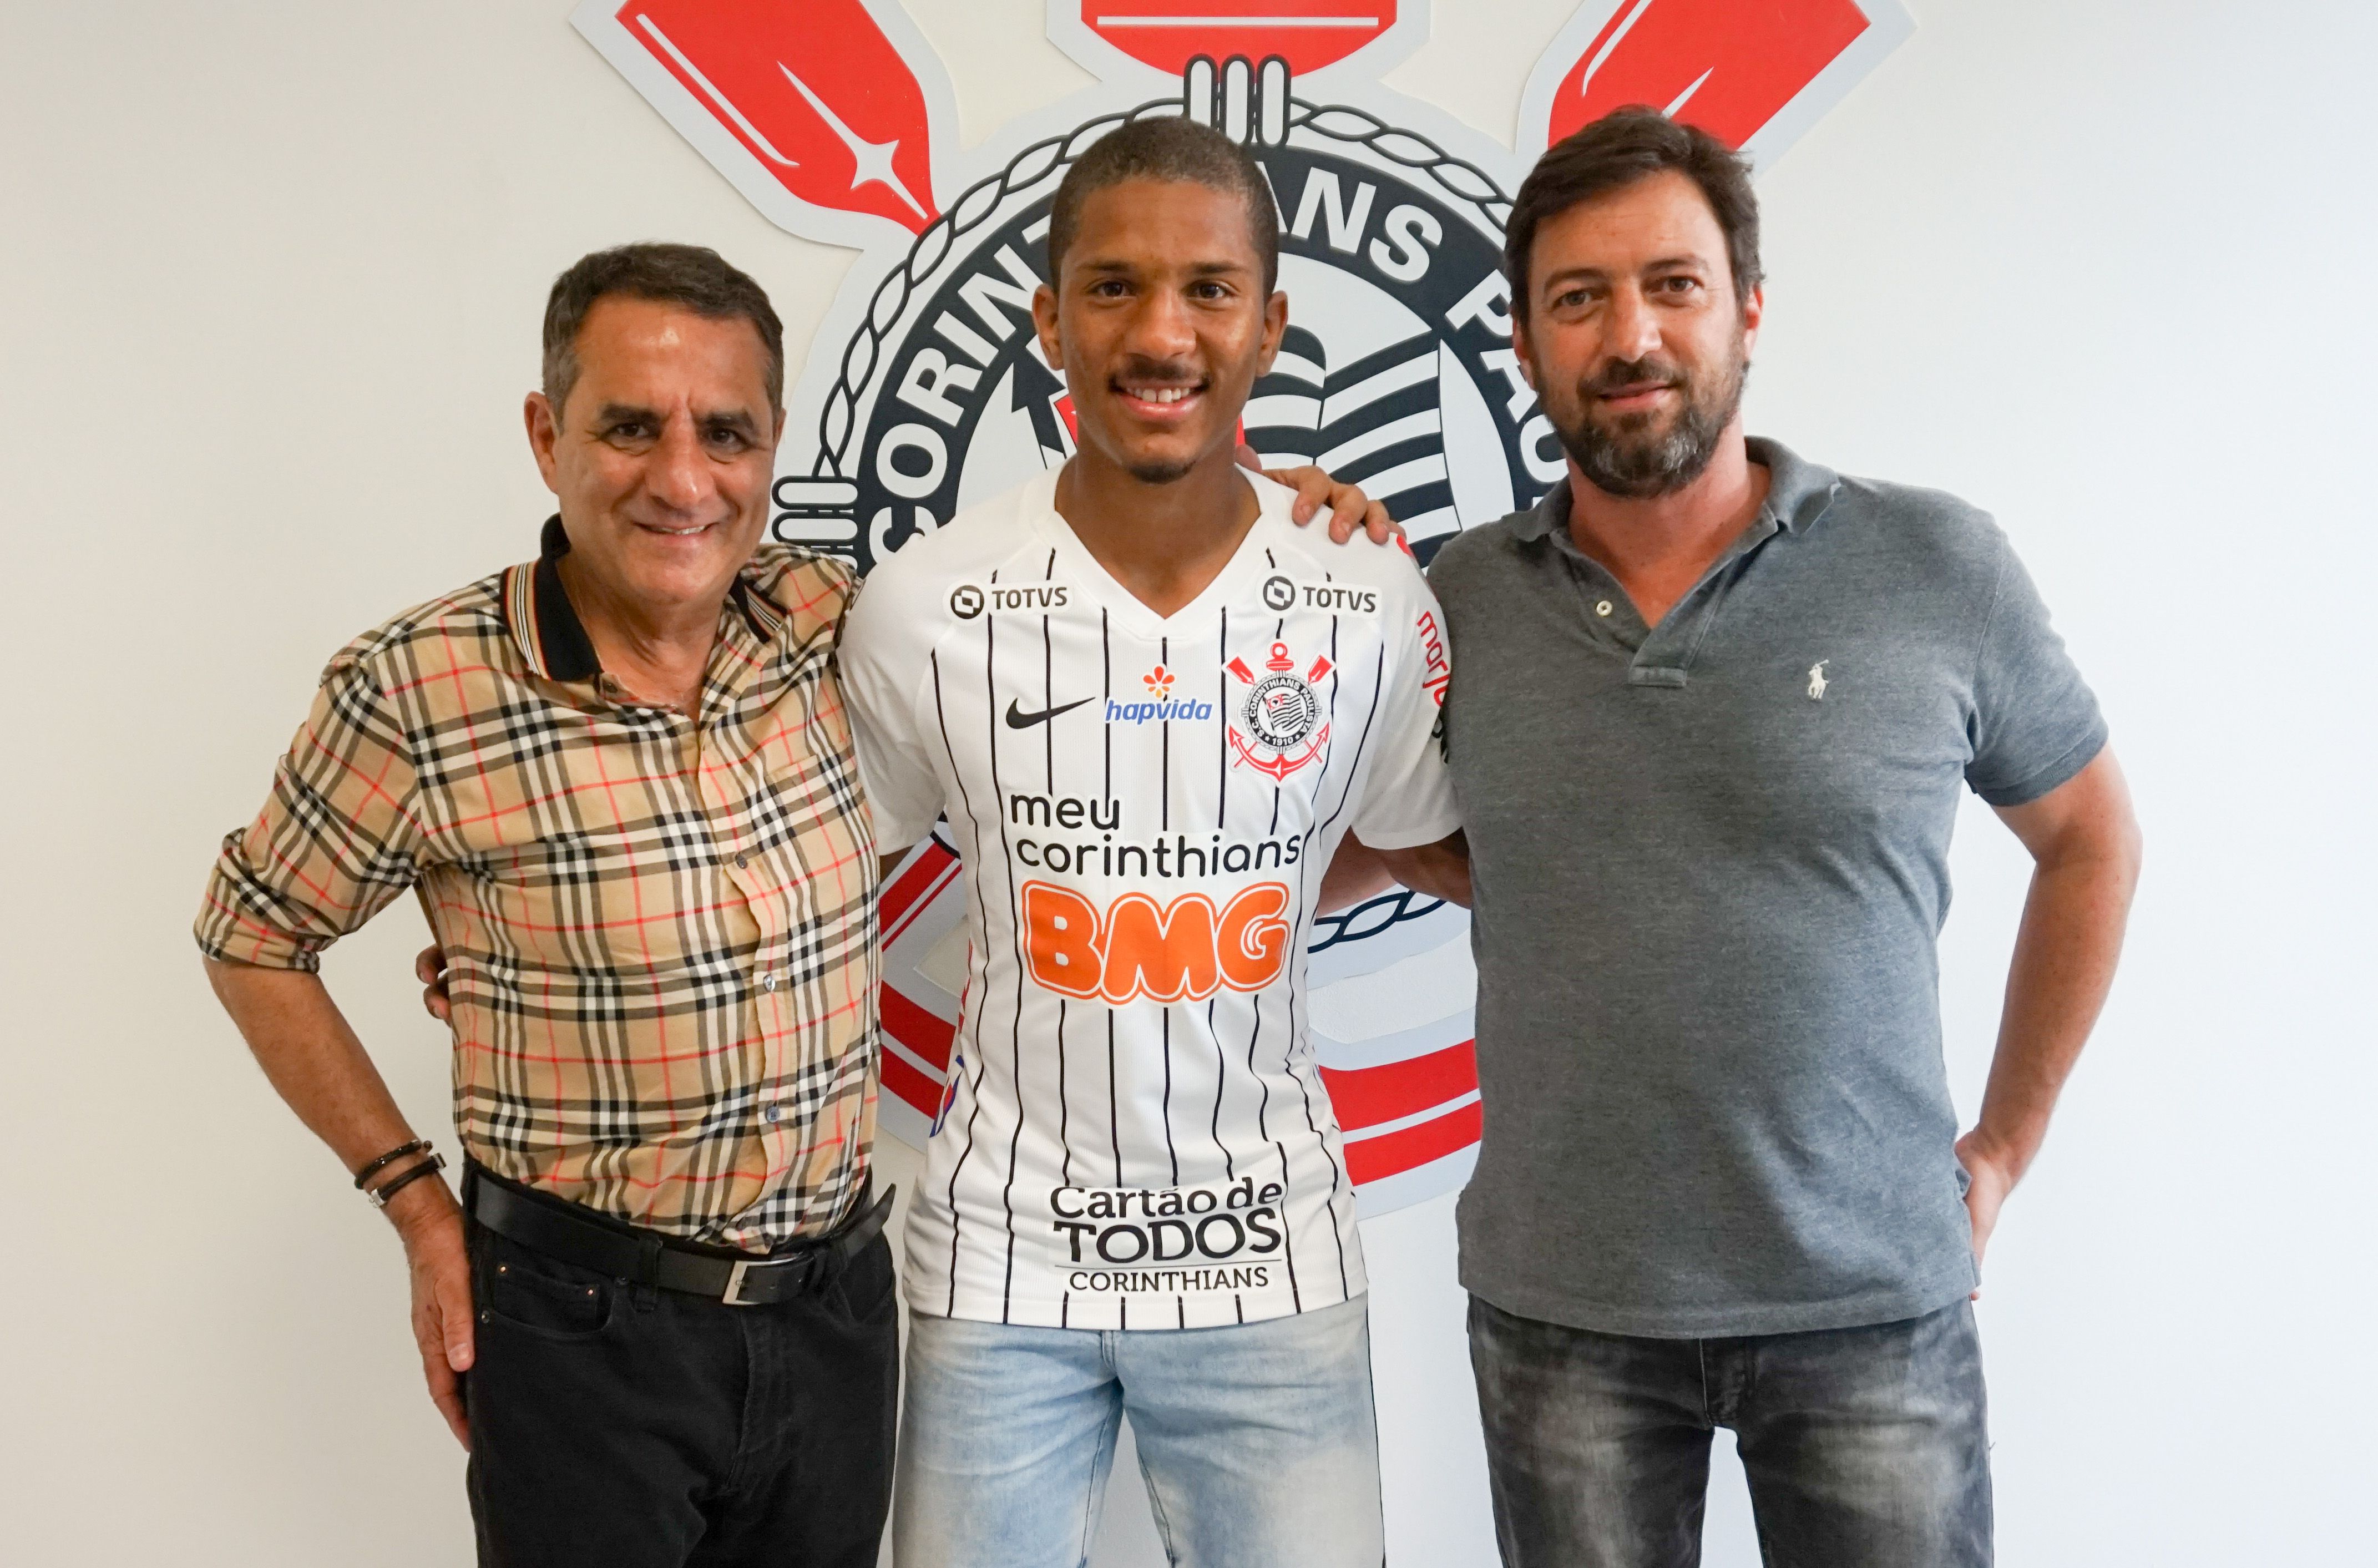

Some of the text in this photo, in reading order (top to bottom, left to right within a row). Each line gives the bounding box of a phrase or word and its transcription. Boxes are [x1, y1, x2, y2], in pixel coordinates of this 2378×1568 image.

[991, 586, 1067, 610] TOTVS
[1303, 586, 1376, 613] TOTVS
[1106, 698, 1213, 725] hapvida
[1249, 678, 1301, 717] CORINTHIANS
[1300, 687, 1315, 733] PAULISTA
[1272, 736, 1293, 746] 1910
[1010, 794, 1120, 830] meu
[1016, 834, 1301, 878] corinthians
[1021, 880, 1291, 1005] BMG
[1050, 1177, 1283, 1218] Cartão de
[1053, 1207, 1282, 1264] TODOS
[1069, 1267, 1269, 1292] CORINTHIANS
